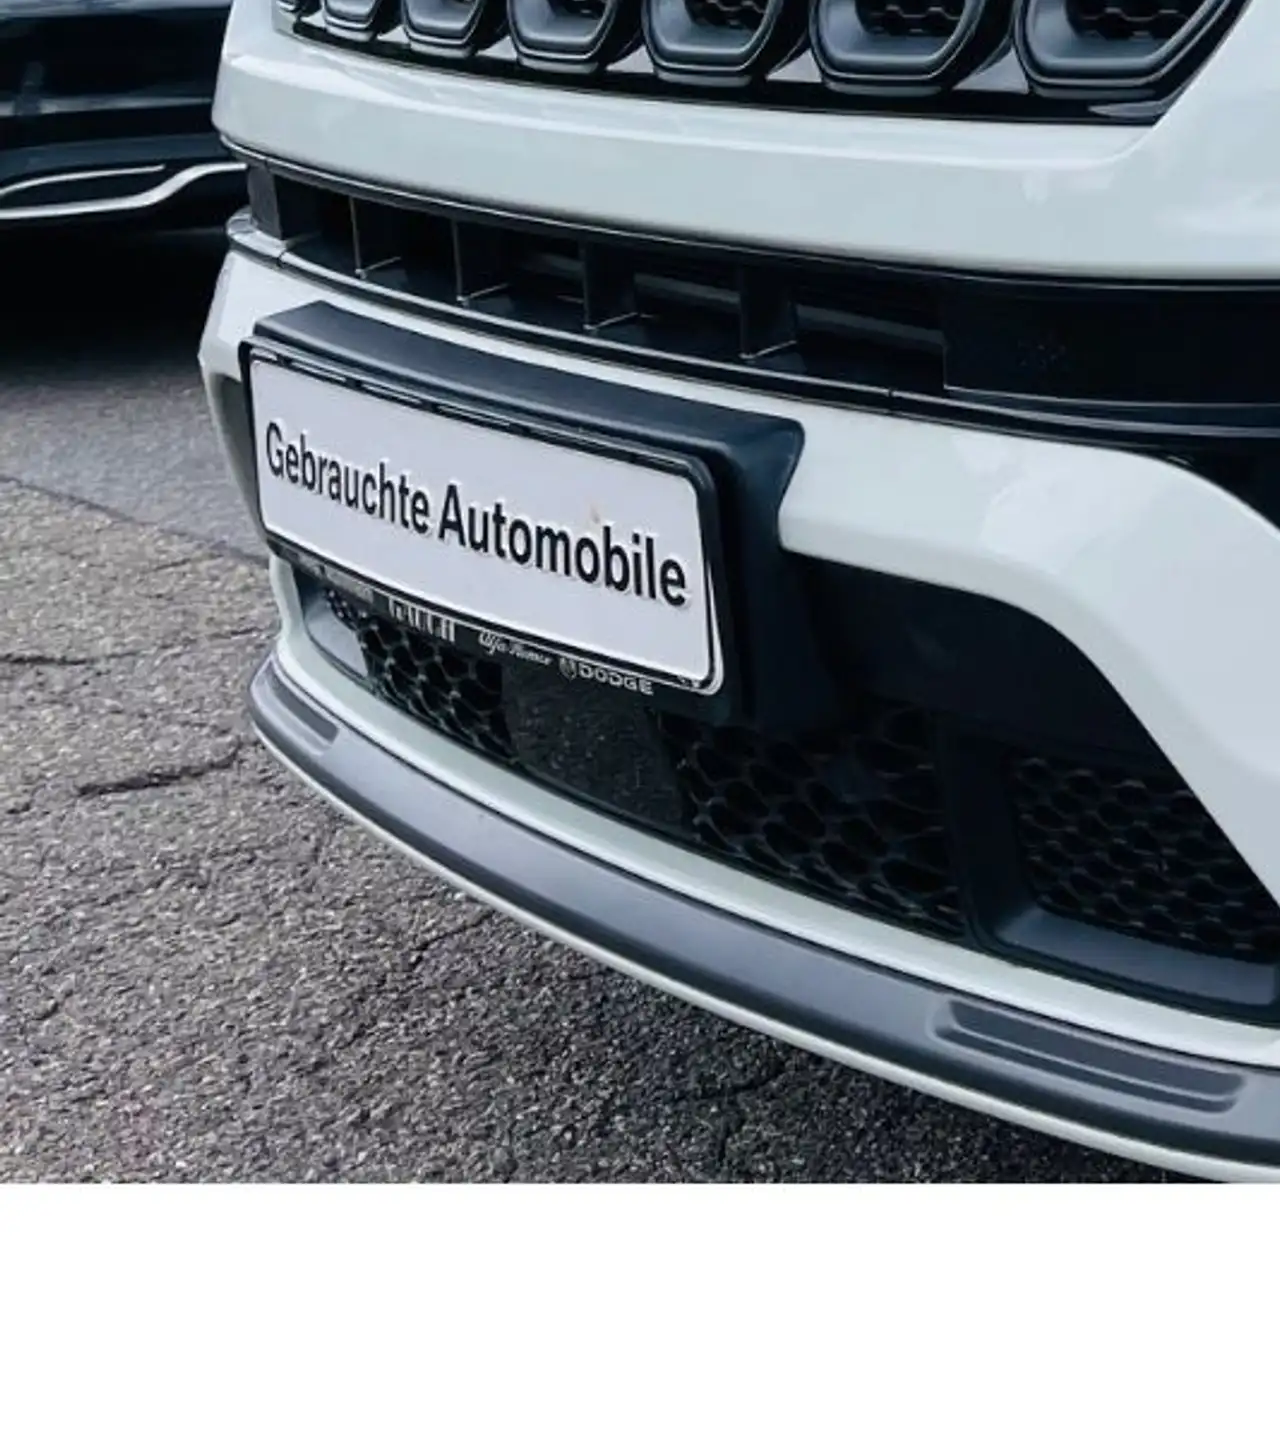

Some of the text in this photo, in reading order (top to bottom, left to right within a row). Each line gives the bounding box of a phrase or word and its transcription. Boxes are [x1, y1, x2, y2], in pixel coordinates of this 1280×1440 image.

[265, 421, 688, 607] Gebrauchte Automobile
[578, 661, 654, 696] DODGE
